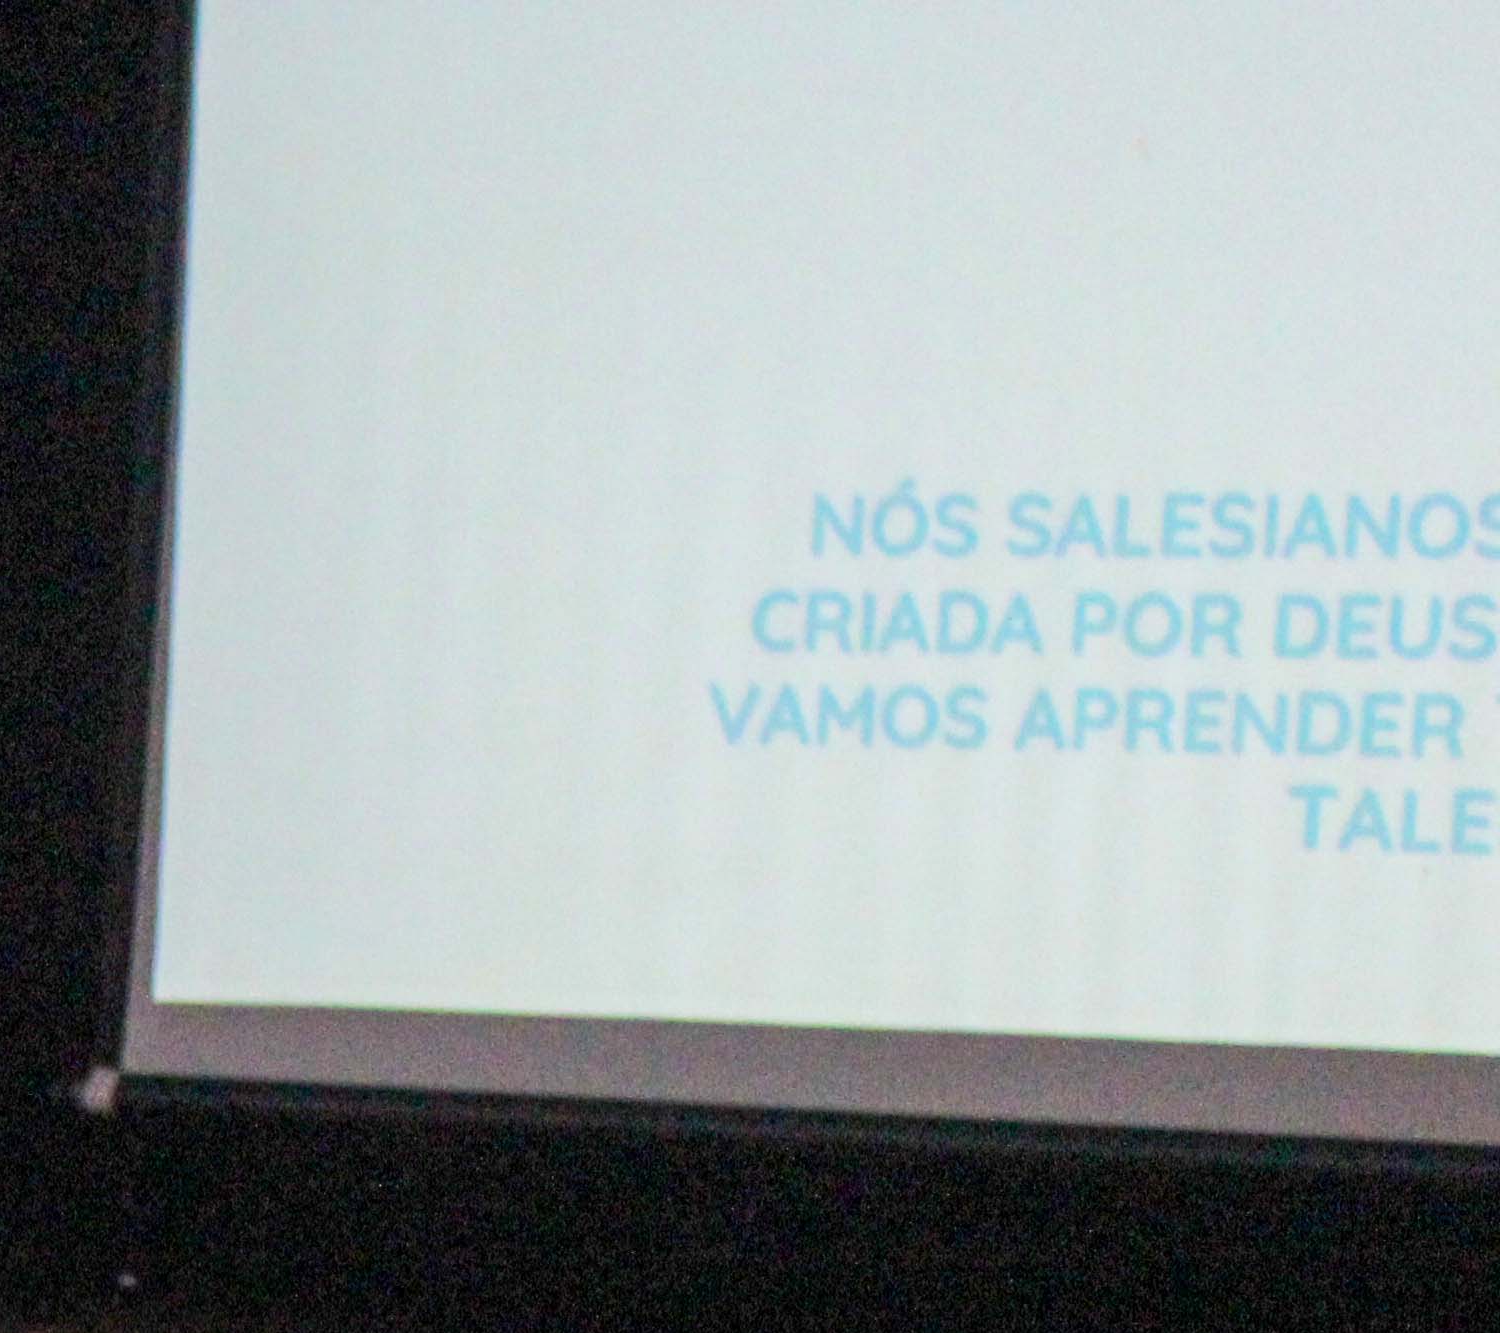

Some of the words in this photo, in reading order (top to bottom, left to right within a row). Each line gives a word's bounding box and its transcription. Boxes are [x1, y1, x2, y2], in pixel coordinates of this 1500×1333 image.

[811, 478, 980, 558] NÓS
[750, 588, 1044, 656] CRIADA
[1071, 591, 1243, 658] POR
[1272, 592, 1499, 661] DEUS
[708, 681, 989, 750] VAMOS
[1012, 685, 1465, 760] APRENDER
[1287, 784, 1496, 857] TALE
